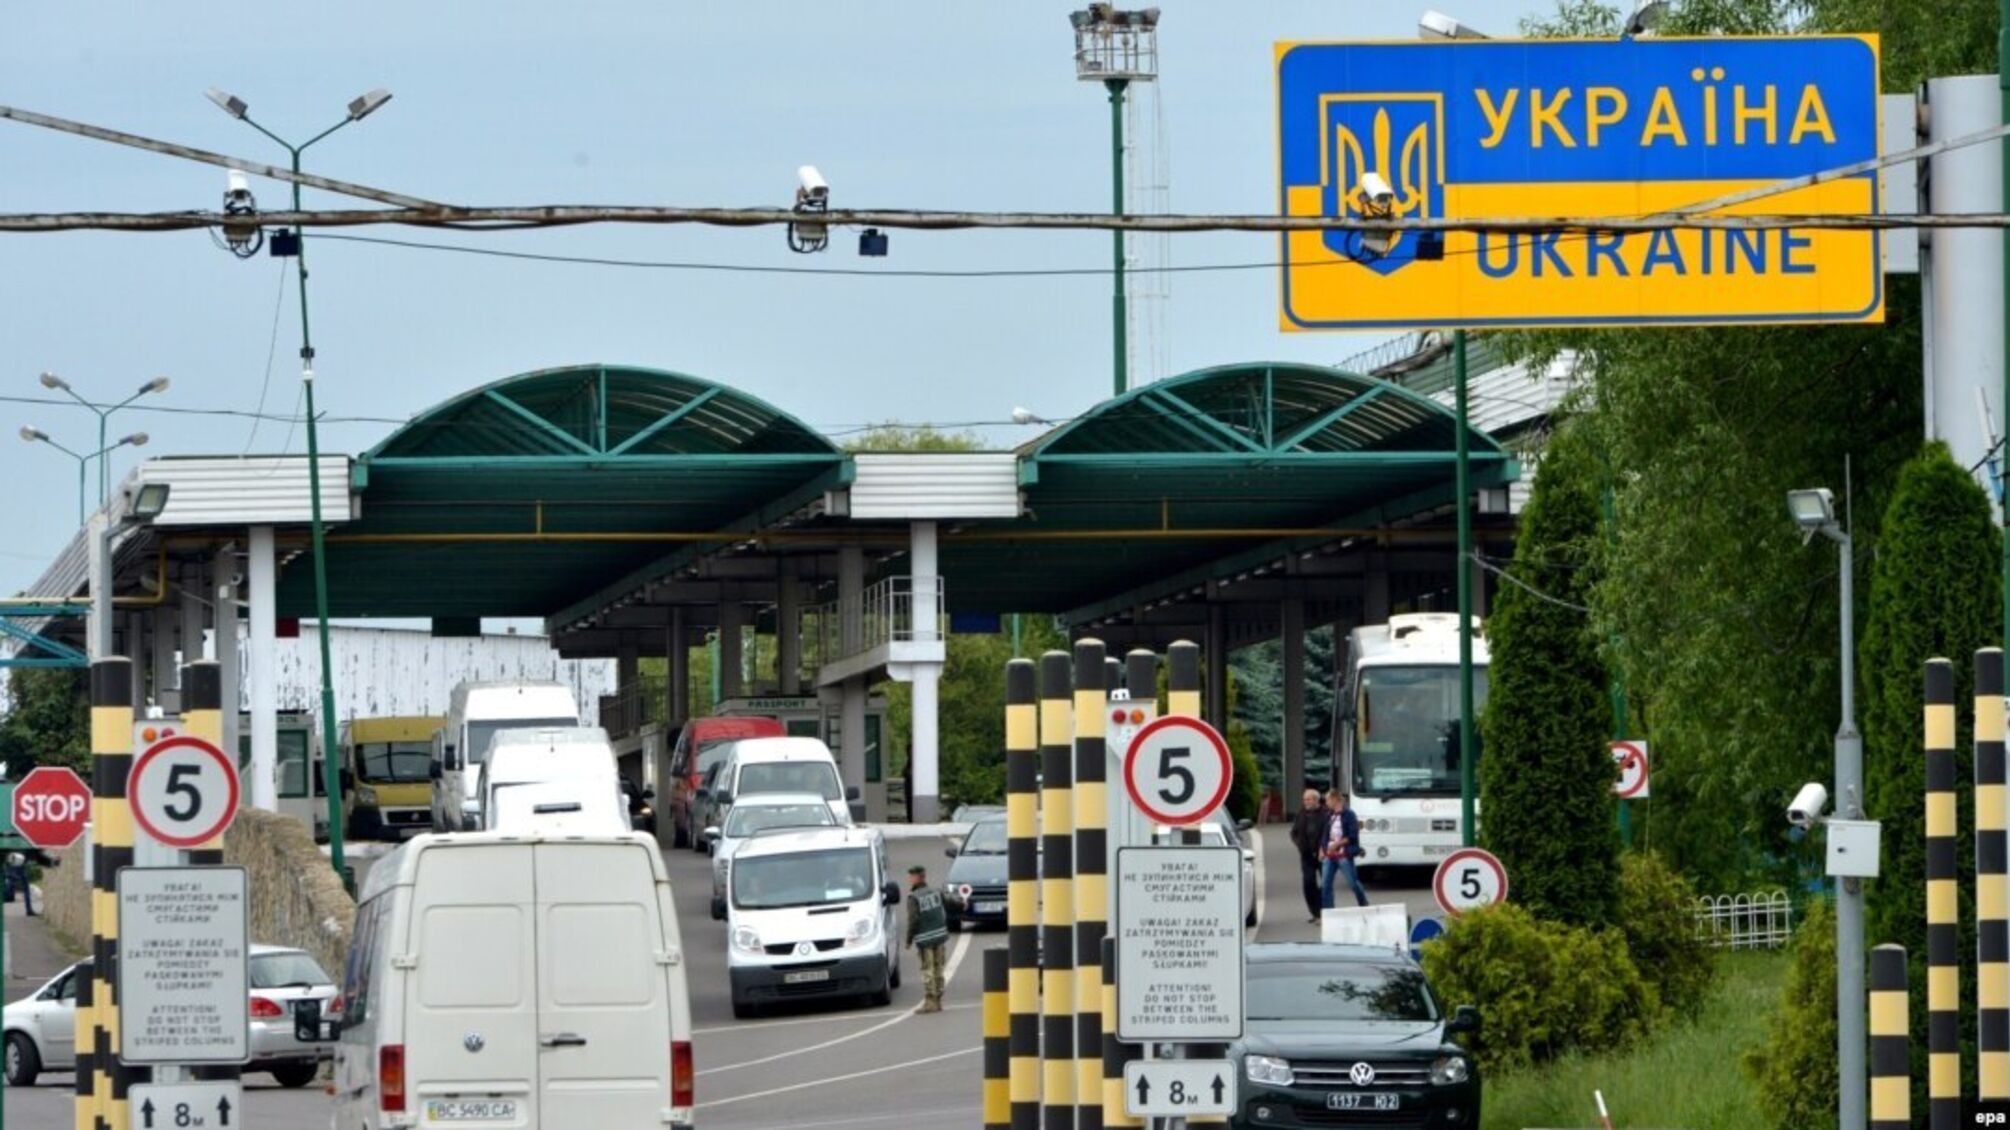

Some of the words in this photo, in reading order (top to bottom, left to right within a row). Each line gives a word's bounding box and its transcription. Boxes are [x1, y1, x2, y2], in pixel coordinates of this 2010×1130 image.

[1474, 67, 1836, 148] УКРАЇНА
[1475, 222, 1816, 278] UKRAINE
[163, 764, 202, 822] 5
[1157, 745, 1196, 805] 5
[19, 794, 85, 823] STOP
[1461, 868, 1481, 900] 5
[1143, 1005, 1194, 1014] BETWEEN
[1198, 1005, 1218, 1014] THE
[1144, 994, 1159, 1003] DO
[1163, 994, 1184, 1003] NOT
[1189, 994, 1217, 1003] STOP
